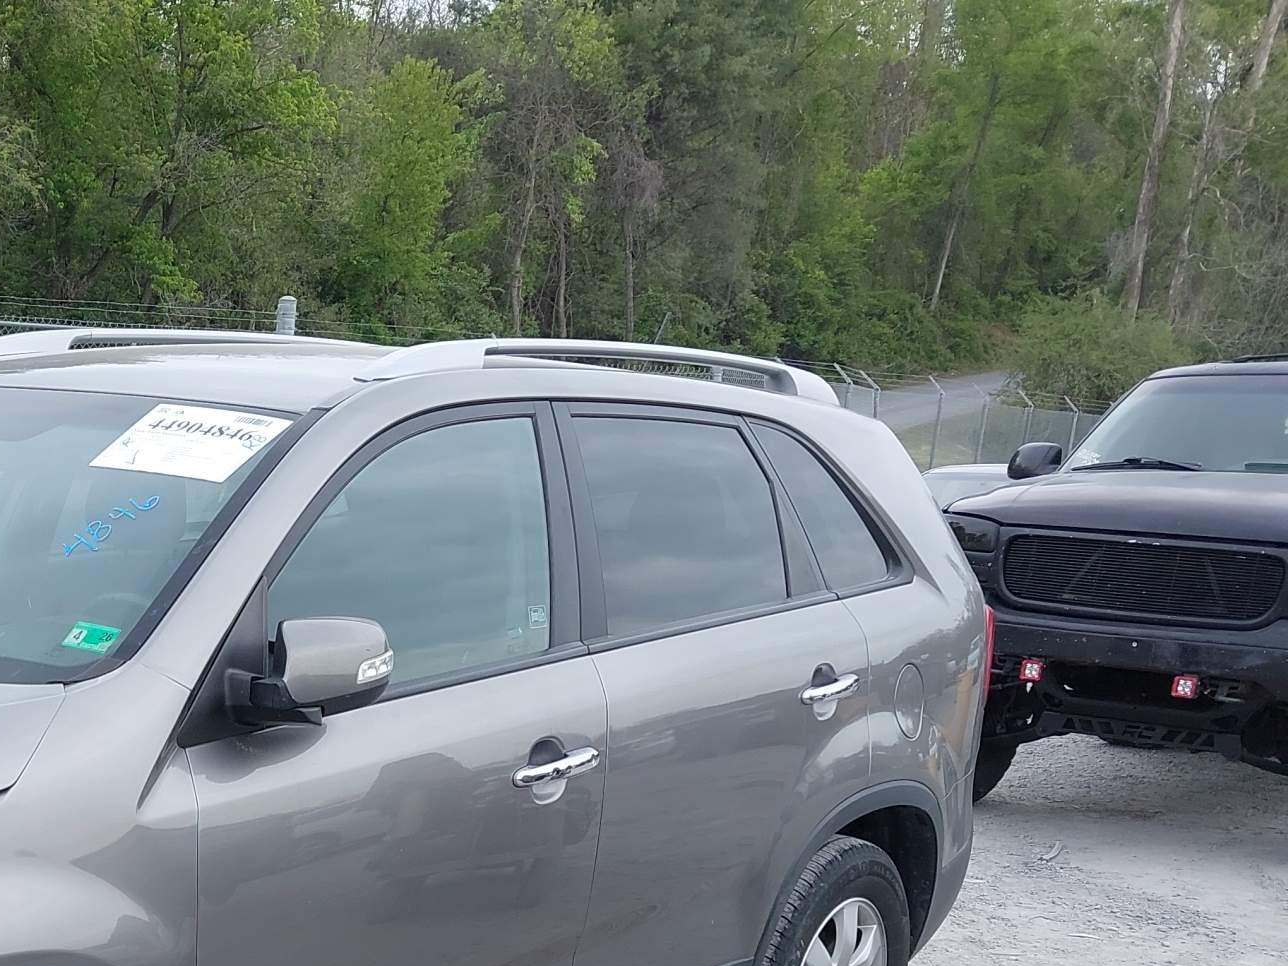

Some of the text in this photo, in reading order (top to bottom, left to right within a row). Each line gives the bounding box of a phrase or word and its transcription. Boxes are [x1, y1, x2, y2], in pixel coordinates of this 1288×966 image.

[149, 418, 260, 442] 44904846
[73, 630, 114, 642] 4 26
